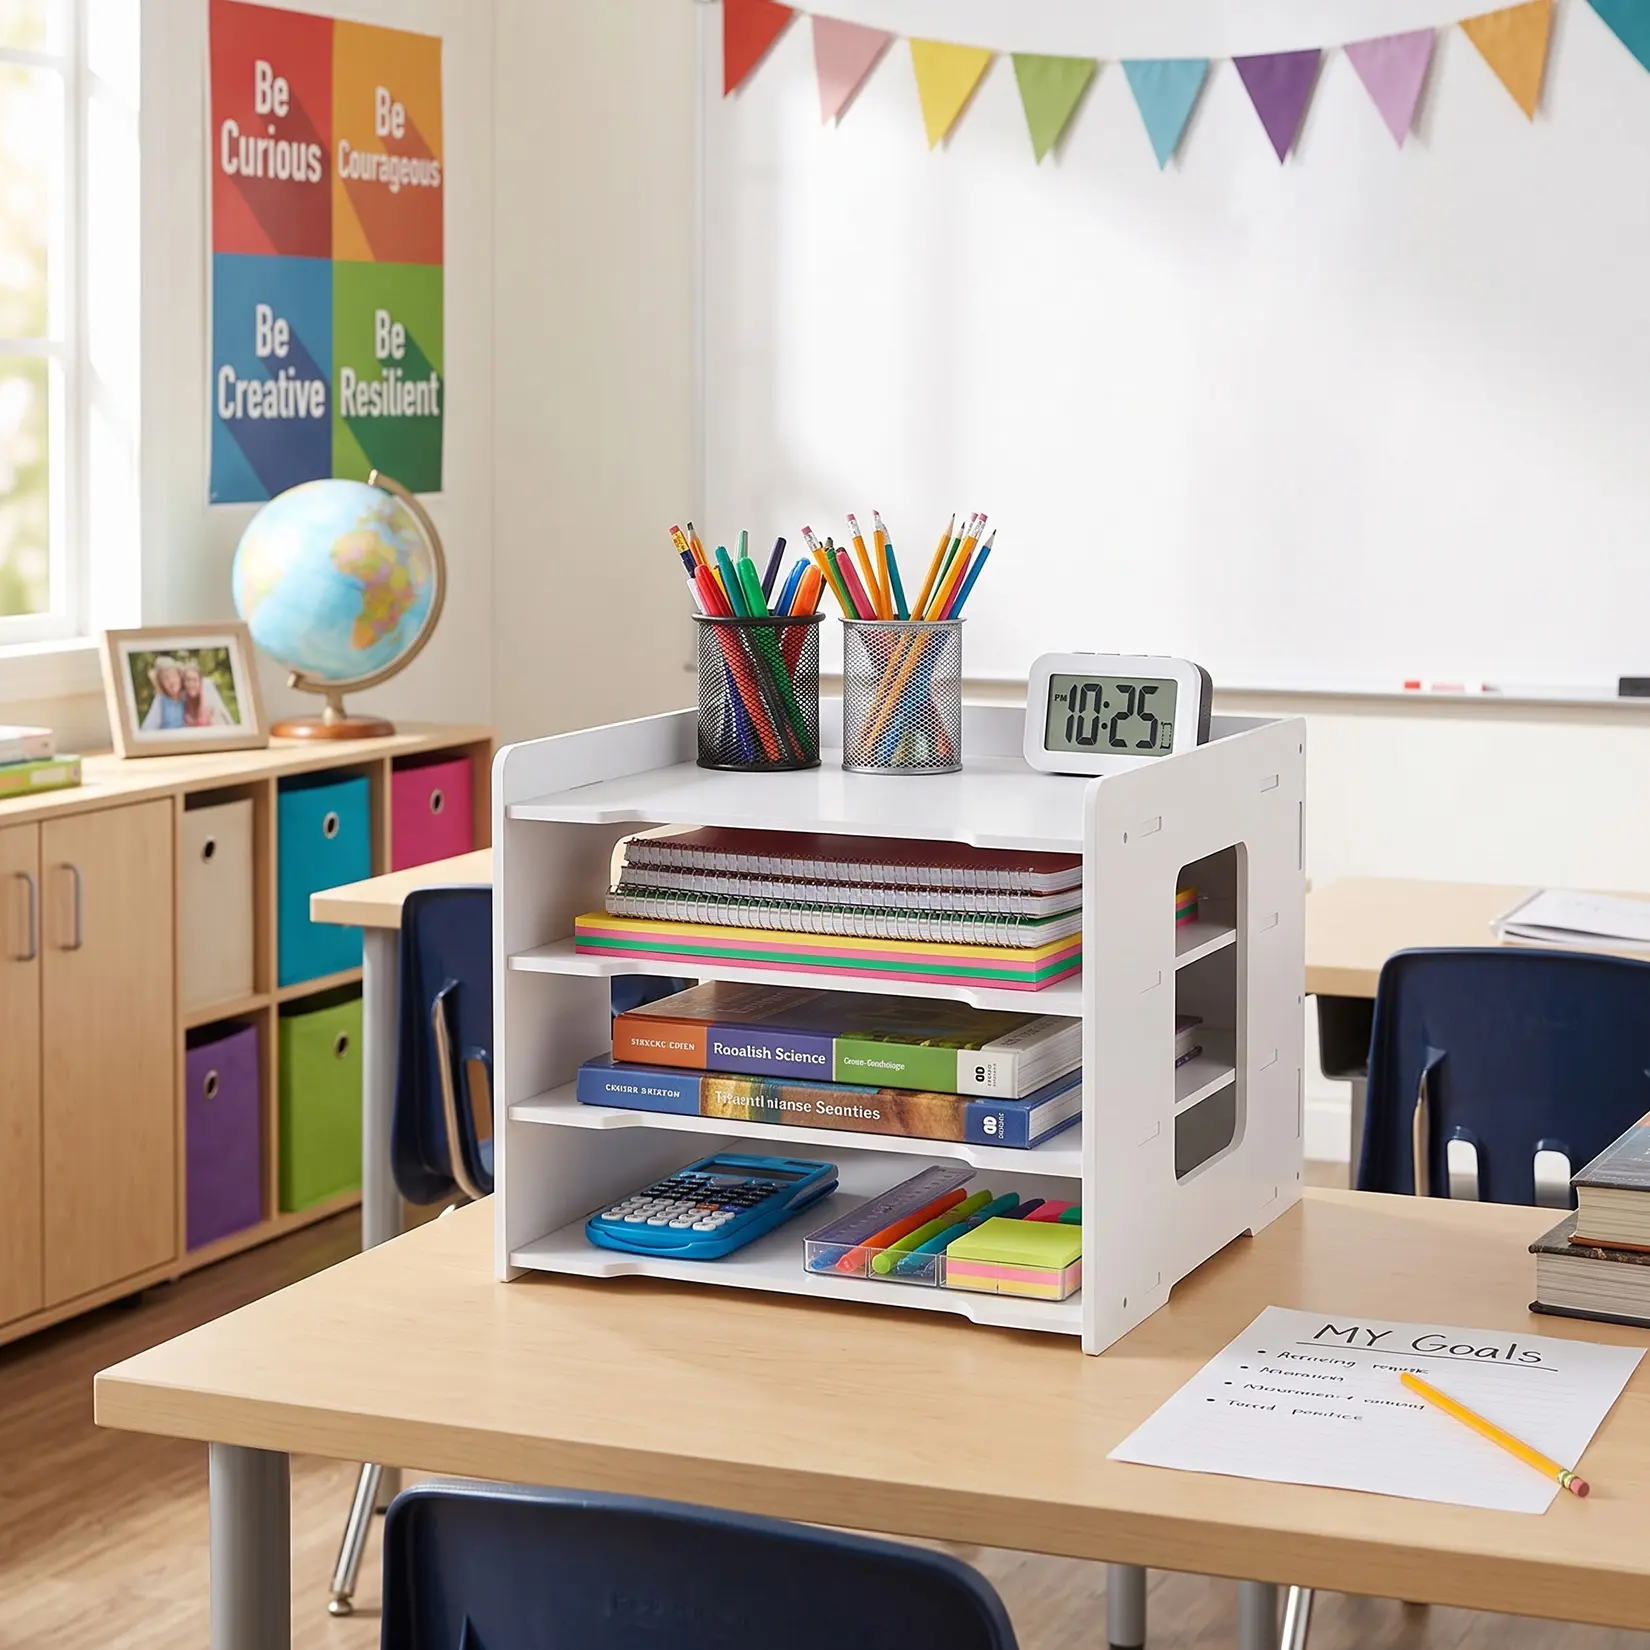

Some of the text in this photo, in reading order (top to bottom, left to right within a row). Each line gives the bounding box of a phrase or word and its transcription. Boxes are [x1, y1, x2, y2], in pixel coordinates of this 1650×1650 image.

[254, 60, 289, 118] Be
[374, 86, 405, 139] Be
[221, 120, 322, 184] Curious
[338, 142, 441, 193] Courageous
[255, 304, 289, 358] Be
[374, 309, 405, 360] Be
[218, 365, 325, 420] Creative
[340, 367, 440, 418] Resilient
[1054, 693, 1067, 702] PM
[1065, 683, 1159, 748] 10:25
[775, 1047, 826, 1064] Science
[815, 1101, 881, 1120] Seanties
[1313, 1323, 1542, 1363] MY Goals
